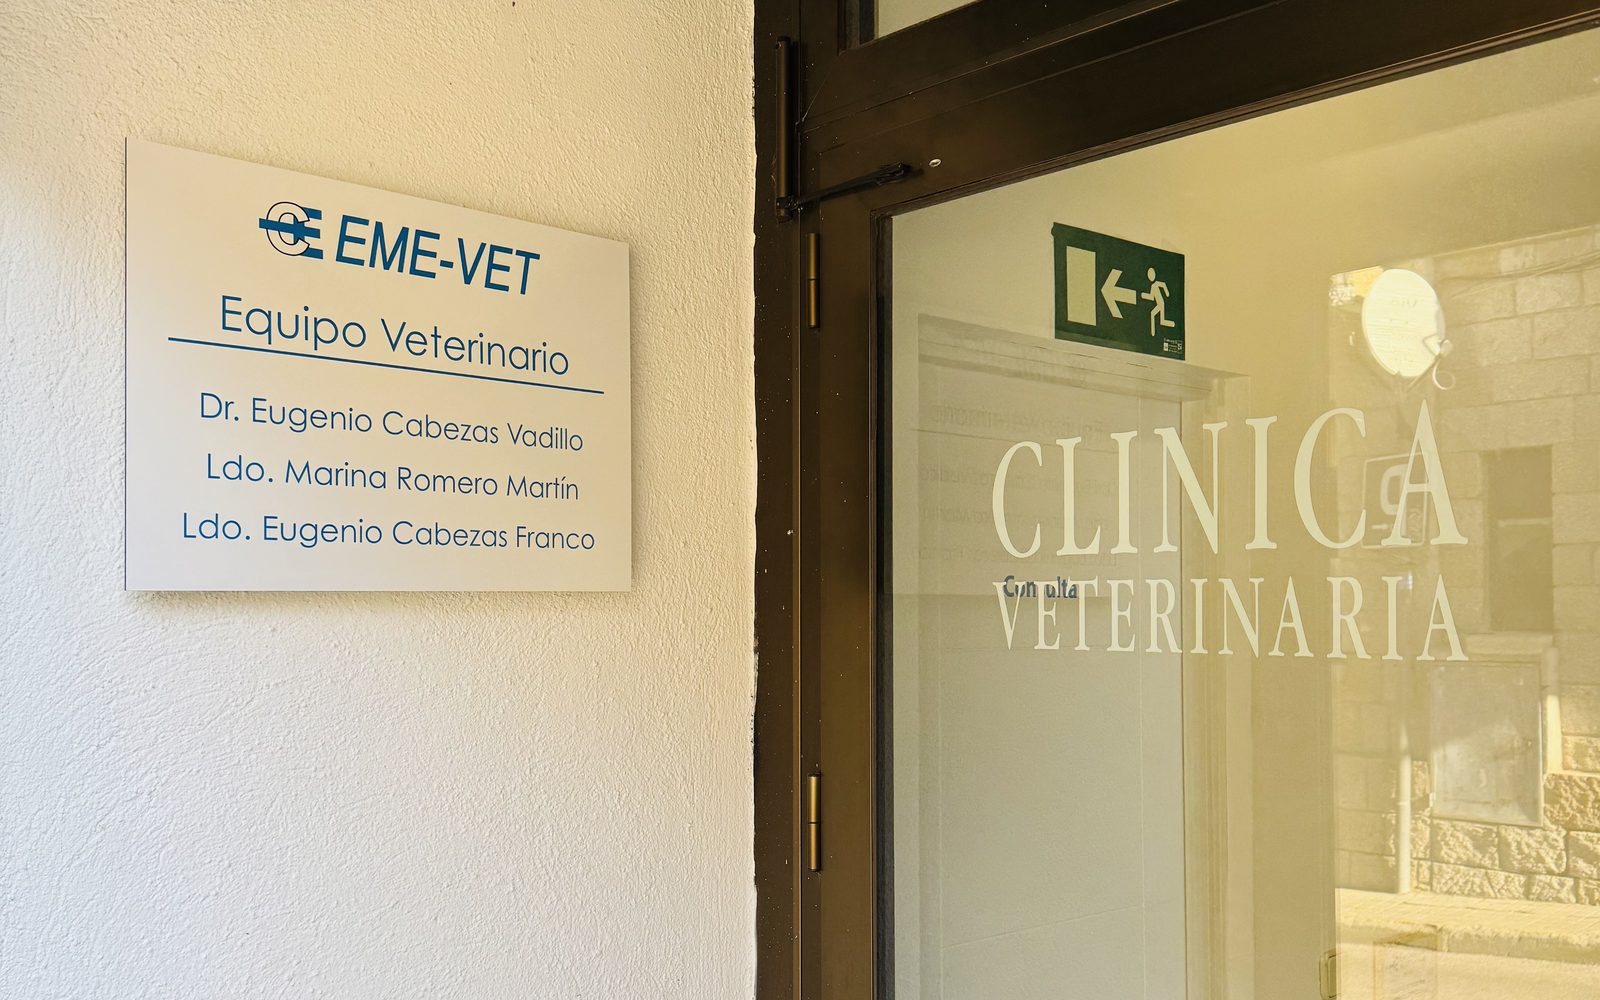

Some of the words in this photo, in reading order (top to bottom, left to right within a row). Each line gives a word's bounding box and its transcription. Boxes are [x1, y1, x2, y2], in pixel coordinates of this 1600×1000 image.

[336, 214, 540, 295] EME-VET
[222, 295, 366, 351] Equipo
[381, 318, 568, 375] Veterinario
[201, 392, 239, 421] Dr.
[253, 397, 372, 433] Eugenio
[383, 411, 498, 444] Cabezas
[507, 423, 583, 451] Vadillo
[208, 453, 273, 482] Ldo.
[285, 459, 386, 489] Marina
[398, 467, 498, 495] Romero
[507, 475, 578, 500] Martín
[992, 400, 1469, 559] CLINICA
[184, 512, 250, 540] Ldo.
[264, 516, 382, 548] Eugenio
[393, 521, 507, 547] Cabezas
[517, 526, 594, 549] Franco
[993, 573, 1470, 662] VETERINARIA
[1003, 575, 1077, 598] Conulta
